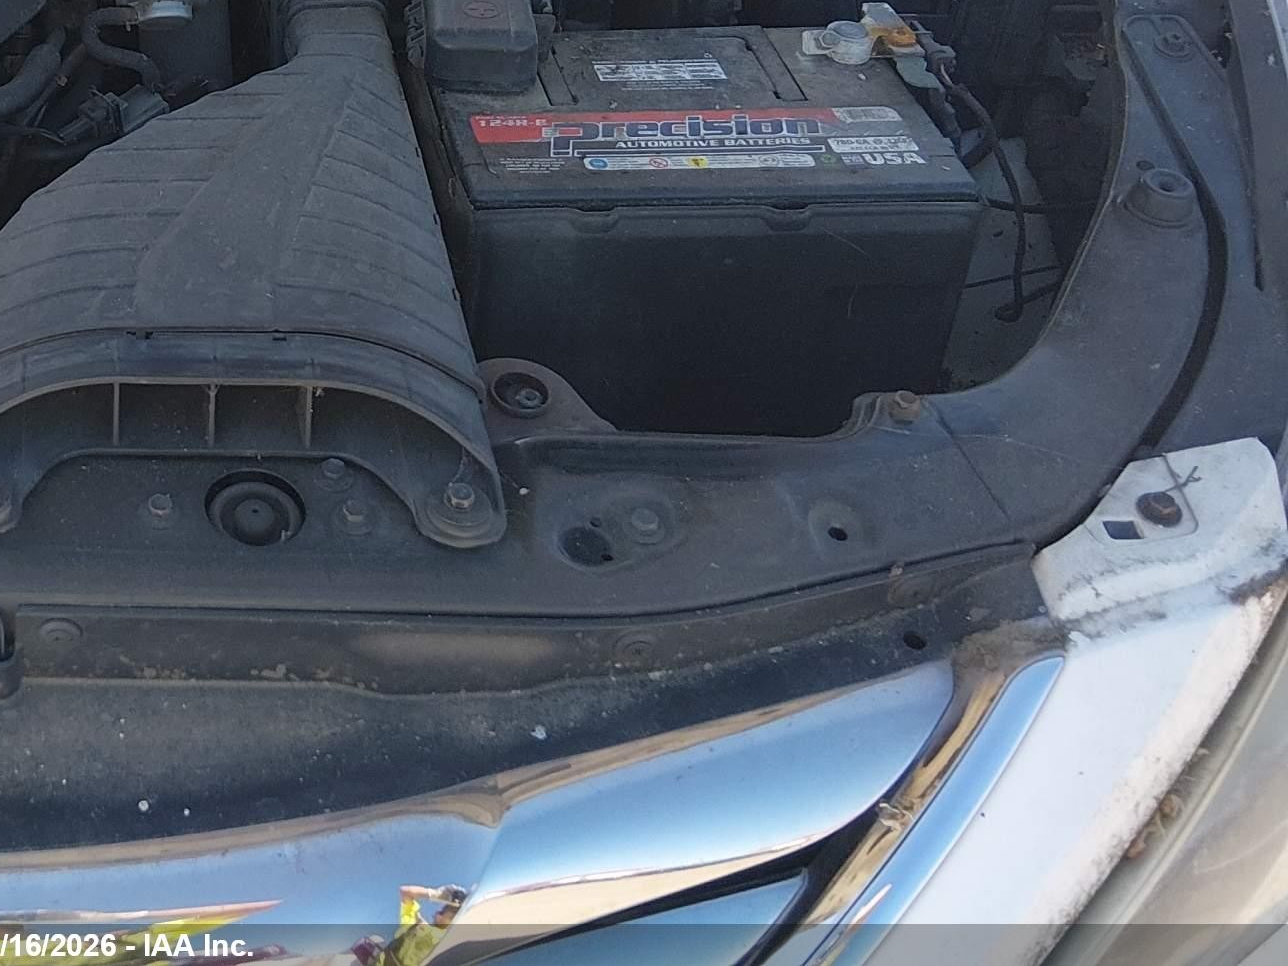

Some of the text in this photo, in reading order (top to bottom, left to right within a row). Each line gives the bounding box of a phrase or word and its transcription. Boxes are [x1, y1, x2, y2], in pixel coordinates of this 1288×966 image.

[614, 137, 811, 149] AUTOMOTIVE BATTERIES
[862, 152, 928, 165] USA
